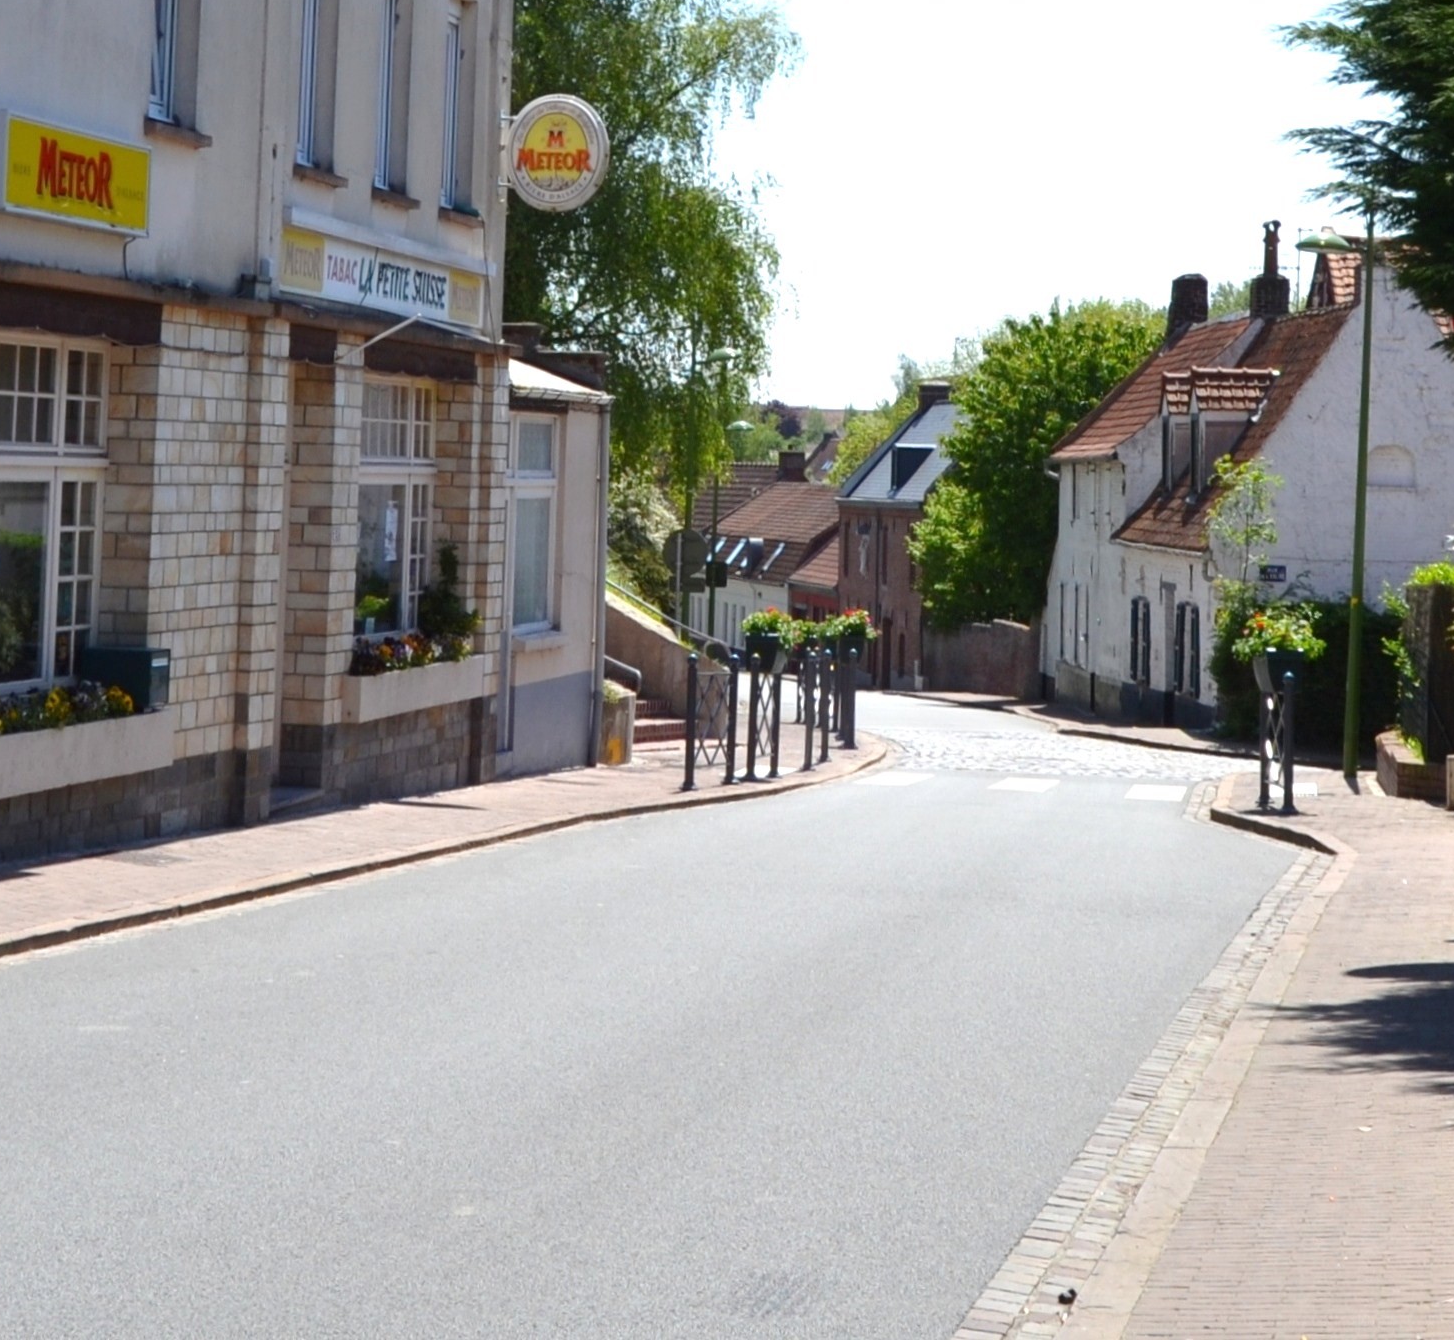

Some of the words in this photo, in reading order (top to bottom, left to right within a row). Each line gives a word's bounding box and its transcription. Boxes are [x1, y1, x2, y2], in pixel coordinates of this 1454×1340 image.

[36, 136, 114, 210] METEOR
[516, 148, 592, 172] METEOR
[283, 240, 321, 281] METEOR
[327, 254, 358, 285] TABAC
[358, 249, 379, 304] LA
[376, 261, 410, 301] PETITE
[412, 269, 447, 309] SUISSE
